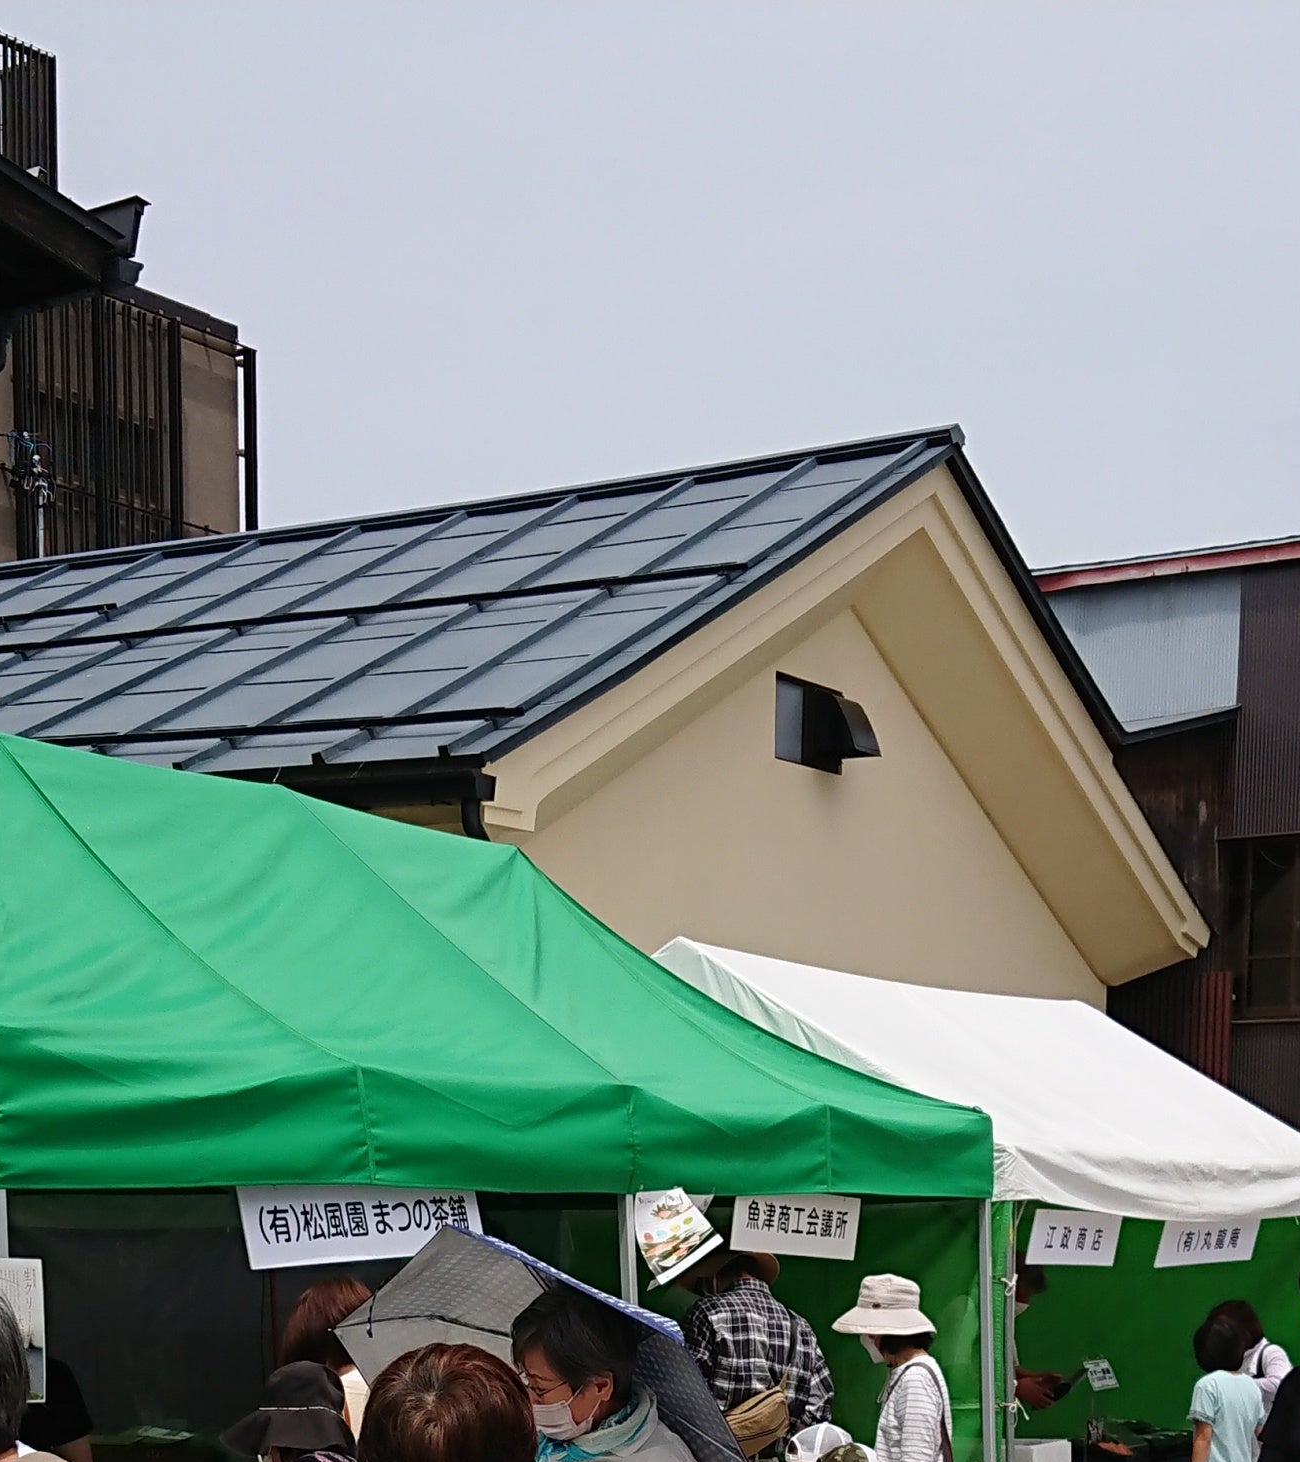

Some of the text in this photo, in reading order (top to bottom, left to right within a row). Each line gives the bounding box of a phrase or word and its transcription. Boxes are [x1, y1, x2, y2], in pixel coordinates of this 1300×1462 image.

[259, 1201, 369, 1244] (有)松風園
[746, 1199, 850, 1240] 魚津商工会議所
